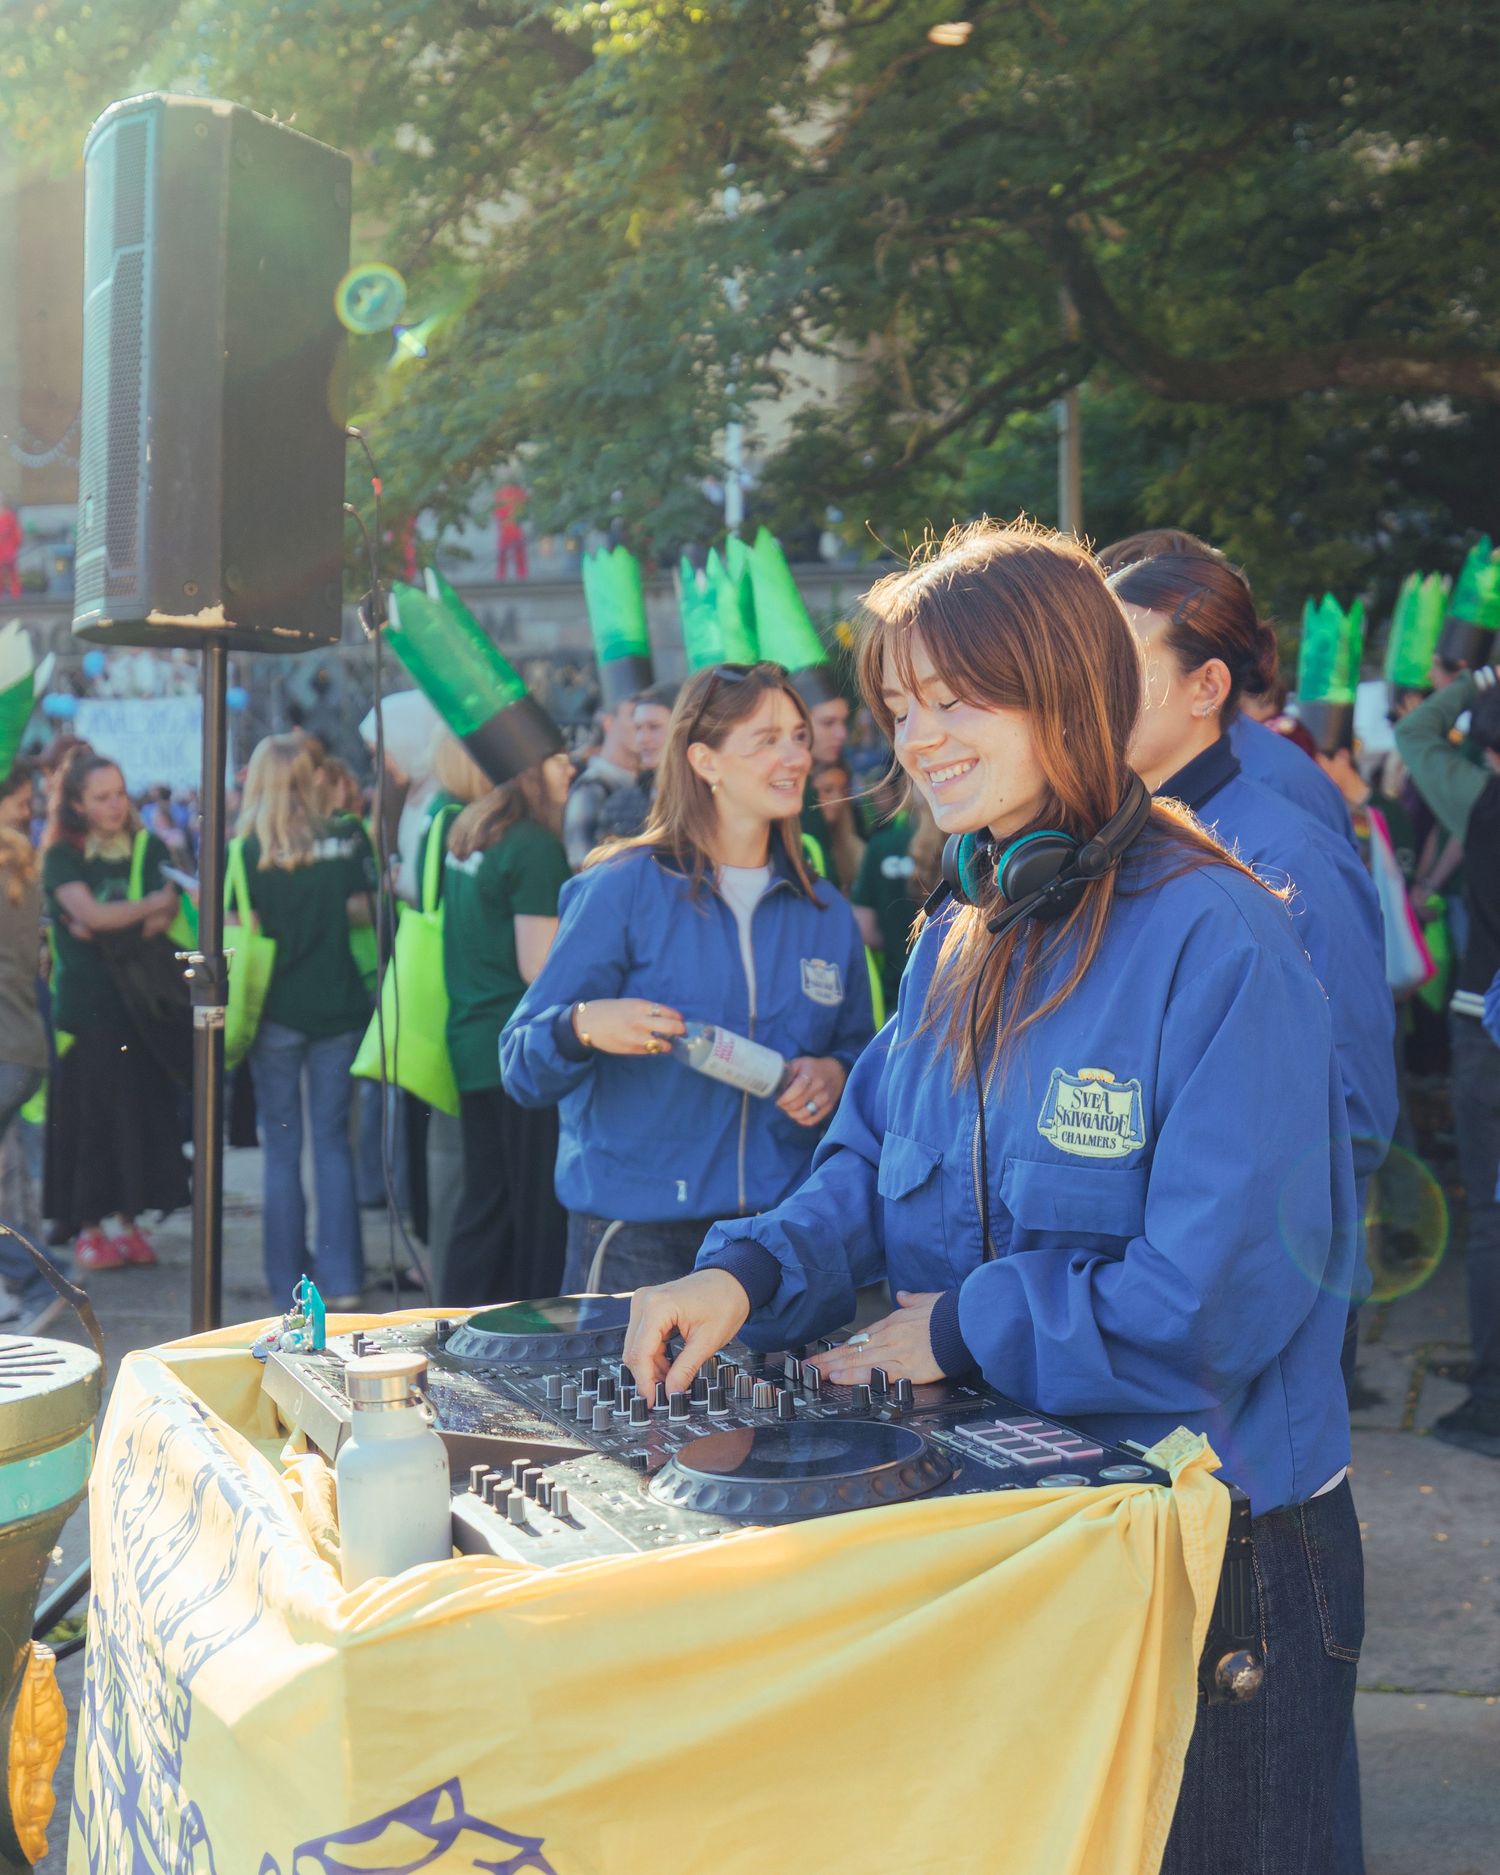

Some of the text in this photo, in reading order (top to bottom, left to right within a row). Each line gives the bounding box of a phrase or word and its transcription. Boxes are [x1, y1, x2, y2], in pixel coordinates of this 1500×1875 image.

[1071, 1088, 1113, 1115] SVEA
[1055, 1105, 1129, 1139] SKIVGARDE
[1061, 1131, 1116, 1149] CHALMERS
